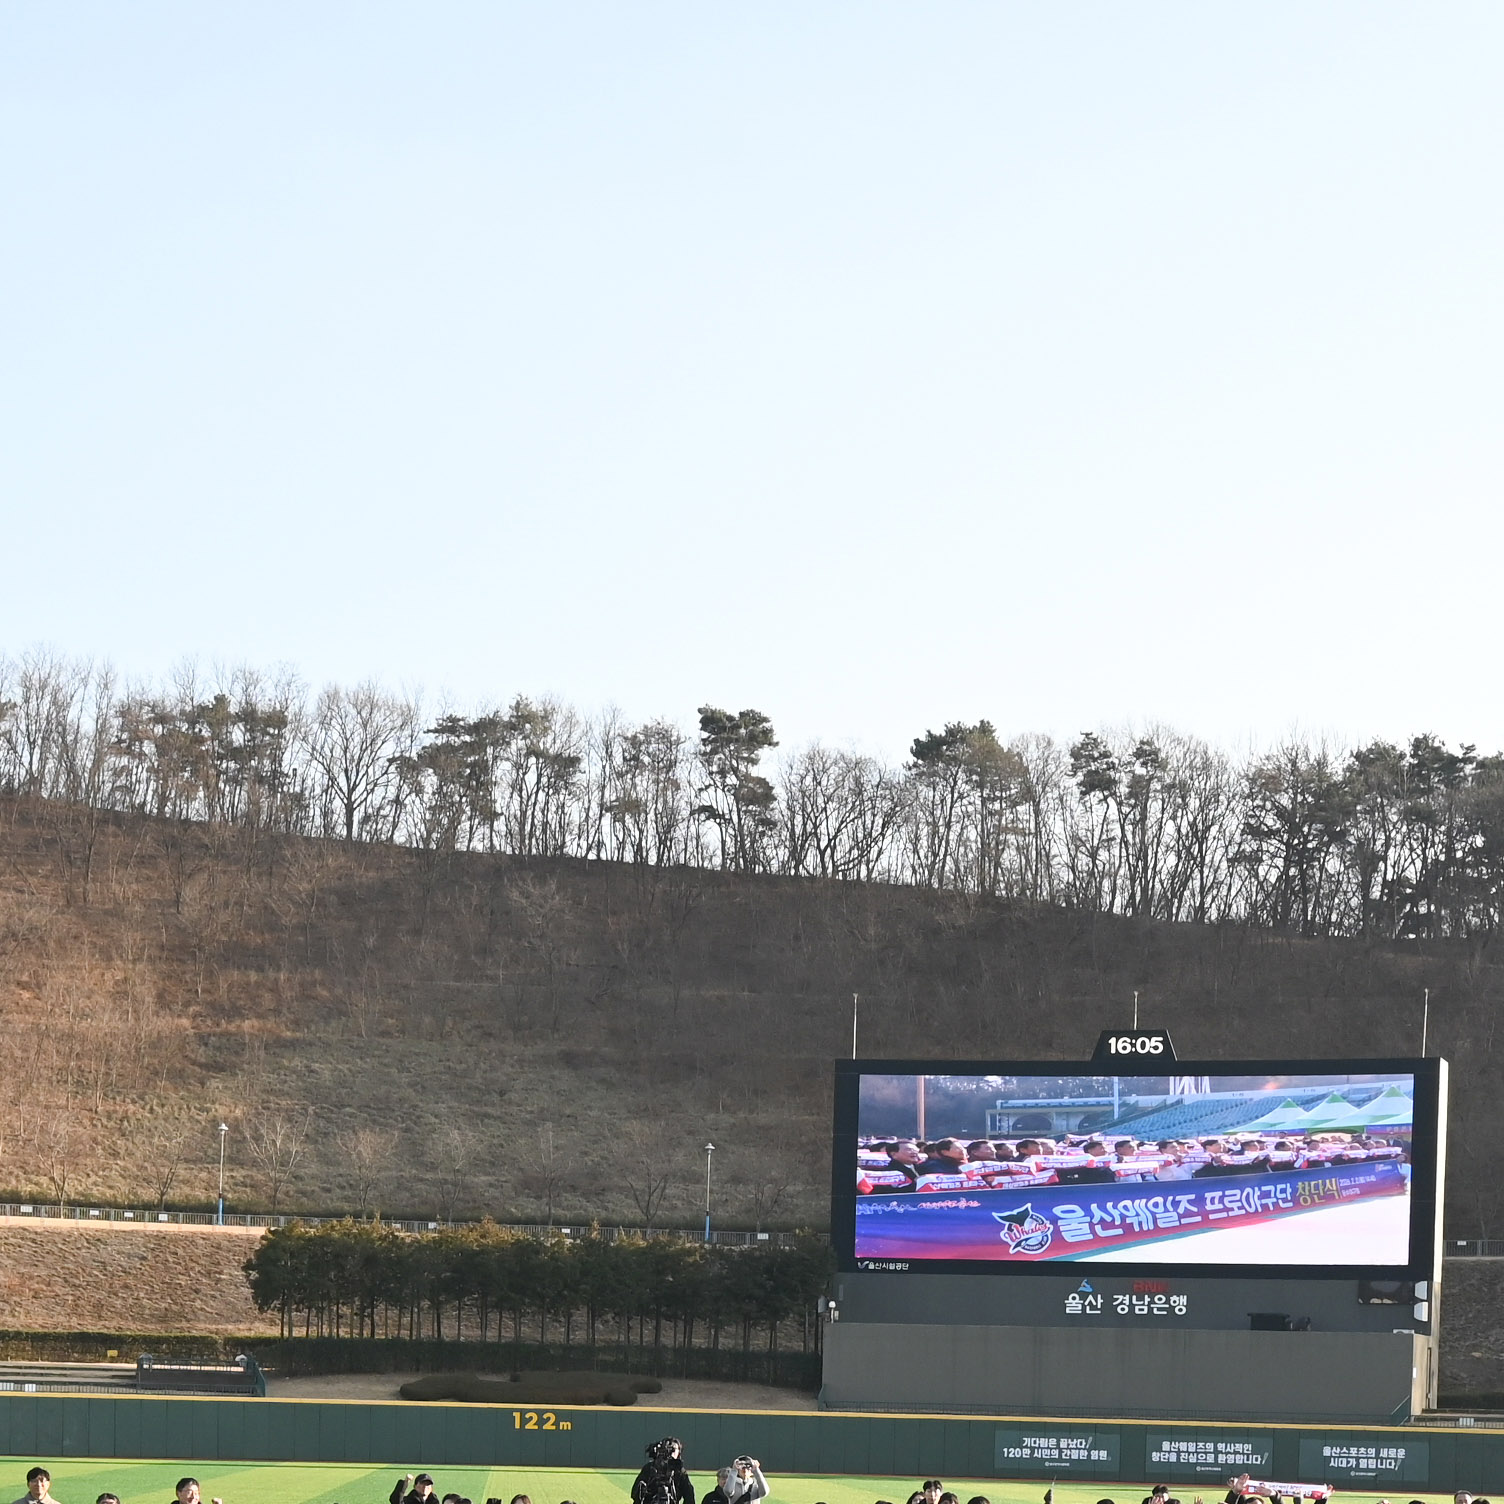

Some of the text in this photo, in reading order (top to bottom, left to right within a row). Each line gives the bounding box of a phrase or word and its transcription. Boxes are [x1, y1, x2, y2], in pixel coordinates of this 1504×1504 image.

[1108, 1037, 1164, 1054] 16:05
[1052, 1177, 1339, 1243] 울산웨일즈 프로야구단 창단식
[868, 1262, 909, 1270] 울산시설공단
[1064, 1293, 1187, 1315] 울산 경남은행
[513, 1412, 572, 1431] 122m
[1023, 1437, 1057, 1448] 기다림은
[1162, 1441, 1252, 1453] 울산웨일즈의 역사적인
[1003, 1448, 1031, 1458] 120만
[1034, 1449, 1058, 1458] 시민의
[1062, 1450, 1087, 1459] 간절한
[1152, 1452, 1261, 1464] 창단을 진심으로 환영합니다
[1323, 1446, 1405, 1458] 울산스포츠의 새로운
[1330, 1458, 1395, 1469] 시대가 열립니다
